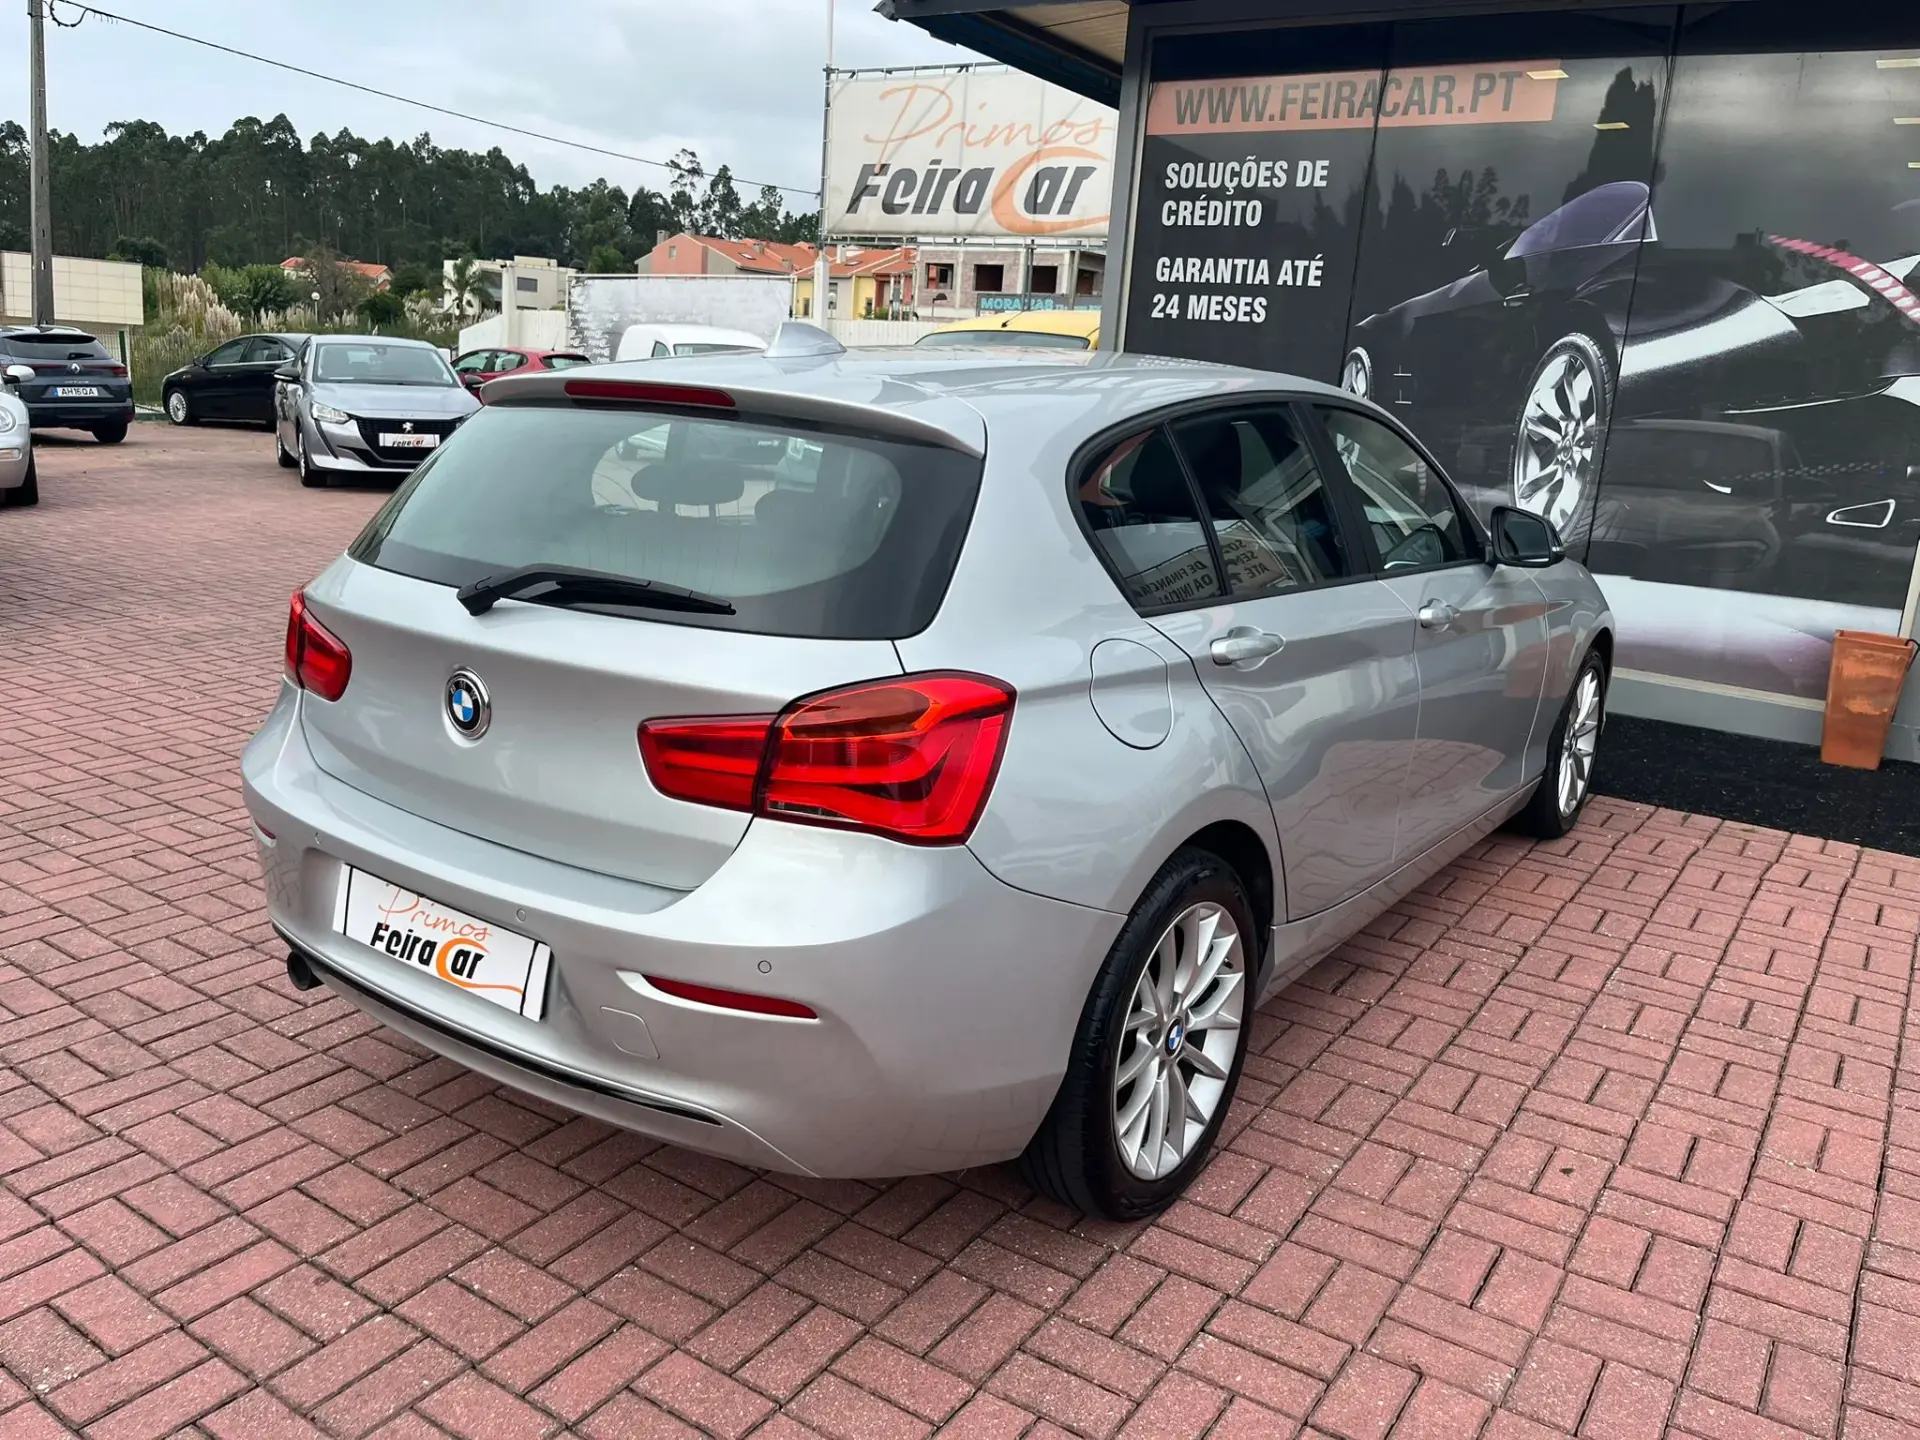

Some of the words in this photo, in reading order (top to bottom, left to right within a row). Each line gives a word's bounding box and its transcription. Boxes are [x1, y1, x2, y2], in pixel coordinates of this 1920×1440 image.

[1175, 71, 1523, 124] WWW.FEIRACAR.PT
[863, 85, 1113, 174] Primos
[1164, 155, 1289, 195] SOLUÇÕES
[1295, 159, 1330, 188] DE
[1161, 194, 1263, 227] CRÉDITO
[1155, 256, 1271, 286] GARANTIA
[1276, 254, 1325, 288] ATÉ
[1150, 293, 1180, 319] 24
[1186, 294, 1268, 324] MESES
[377, 887, 493, 942] Primos
